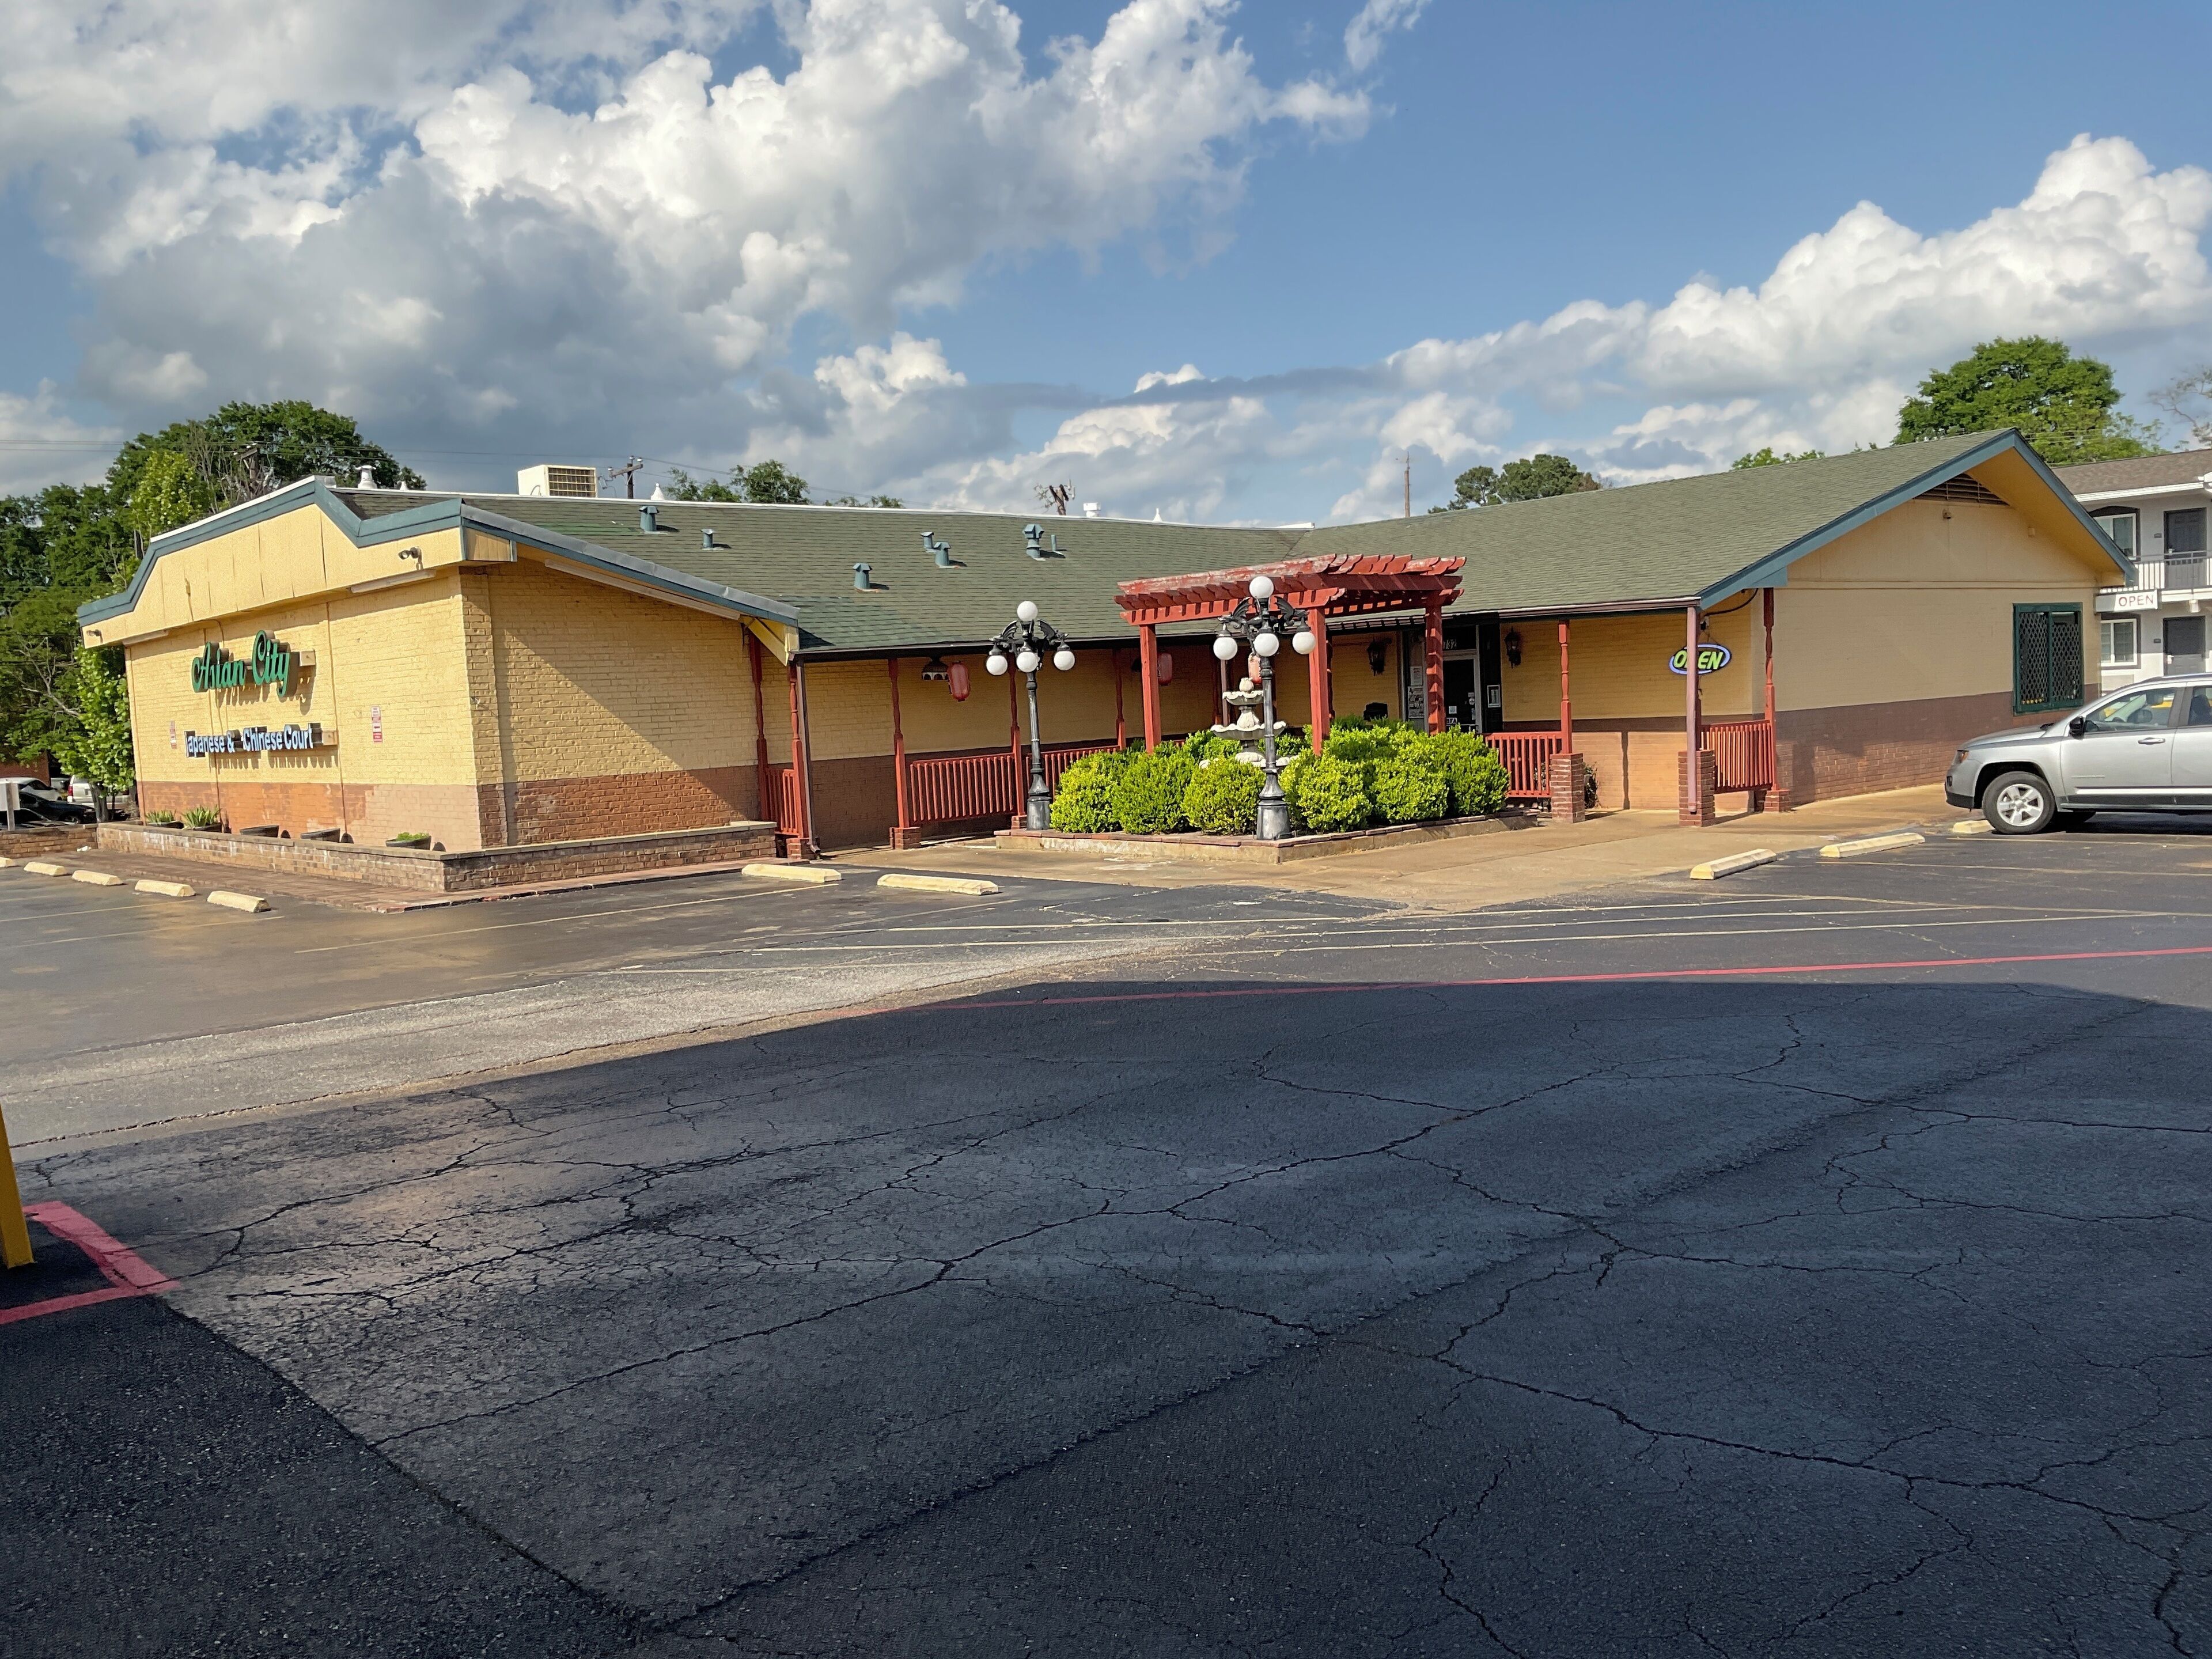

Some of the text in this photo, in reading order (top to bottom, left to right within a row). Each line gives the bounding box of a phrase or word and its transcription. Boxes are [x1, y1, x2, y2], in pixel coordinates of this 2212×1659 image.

[2118, 594, 2154, 607] OPEN
[191, 630, 290, 697] Asian City
[1673, 650, 1724, 670] OEN
[184, 730, 225, 758] Japanese
[227, 730, 236, 753] &
[243, 726, 283, 752] Chinese
[284, 723, 314, 750] Court
